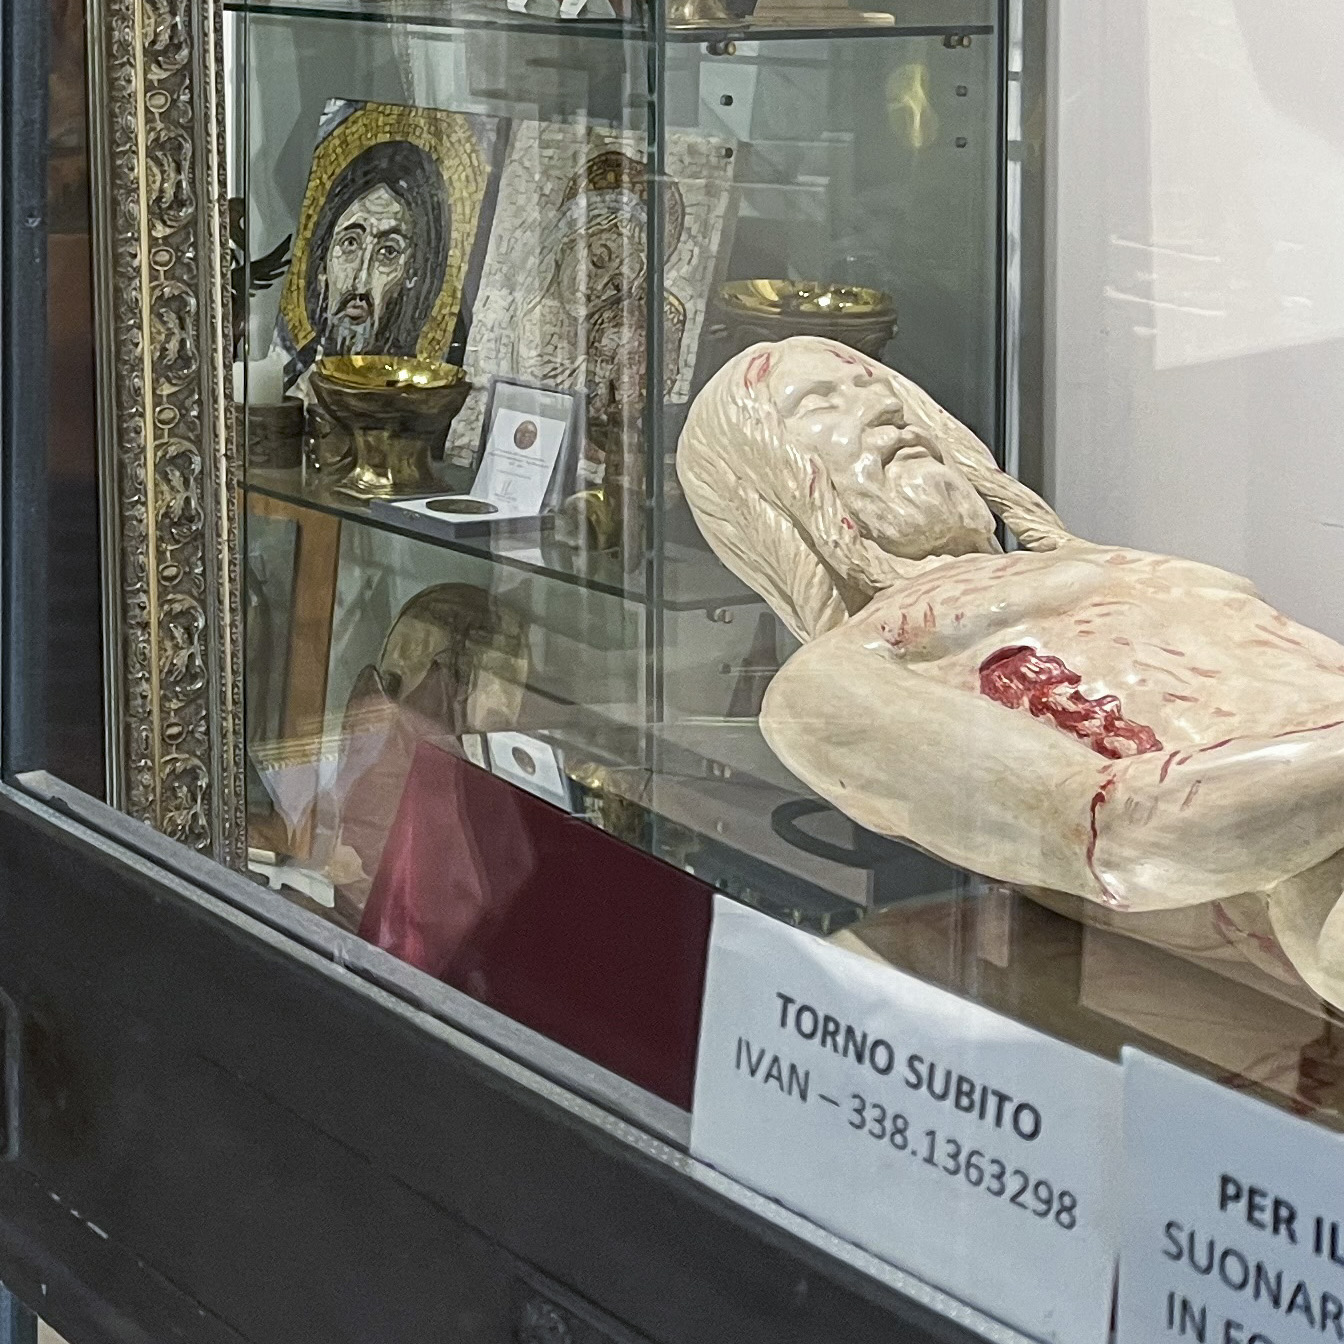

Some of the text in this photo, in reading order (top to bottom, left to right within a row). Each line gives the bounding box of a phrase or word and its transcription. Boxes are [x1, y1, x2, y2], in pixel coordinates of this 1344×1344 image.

[776, 992, 1042, 1141] TORNO SUBITO
[735, 1036, 810, 1104] IVAN
[847, 1093, 1078, 1231] 338.1363298
[1219, 1172, 1298, 1246] PER
[1162, 1220, 1344, 1341] SUONAR
[1167, 1291, 1207, 1344] IN
